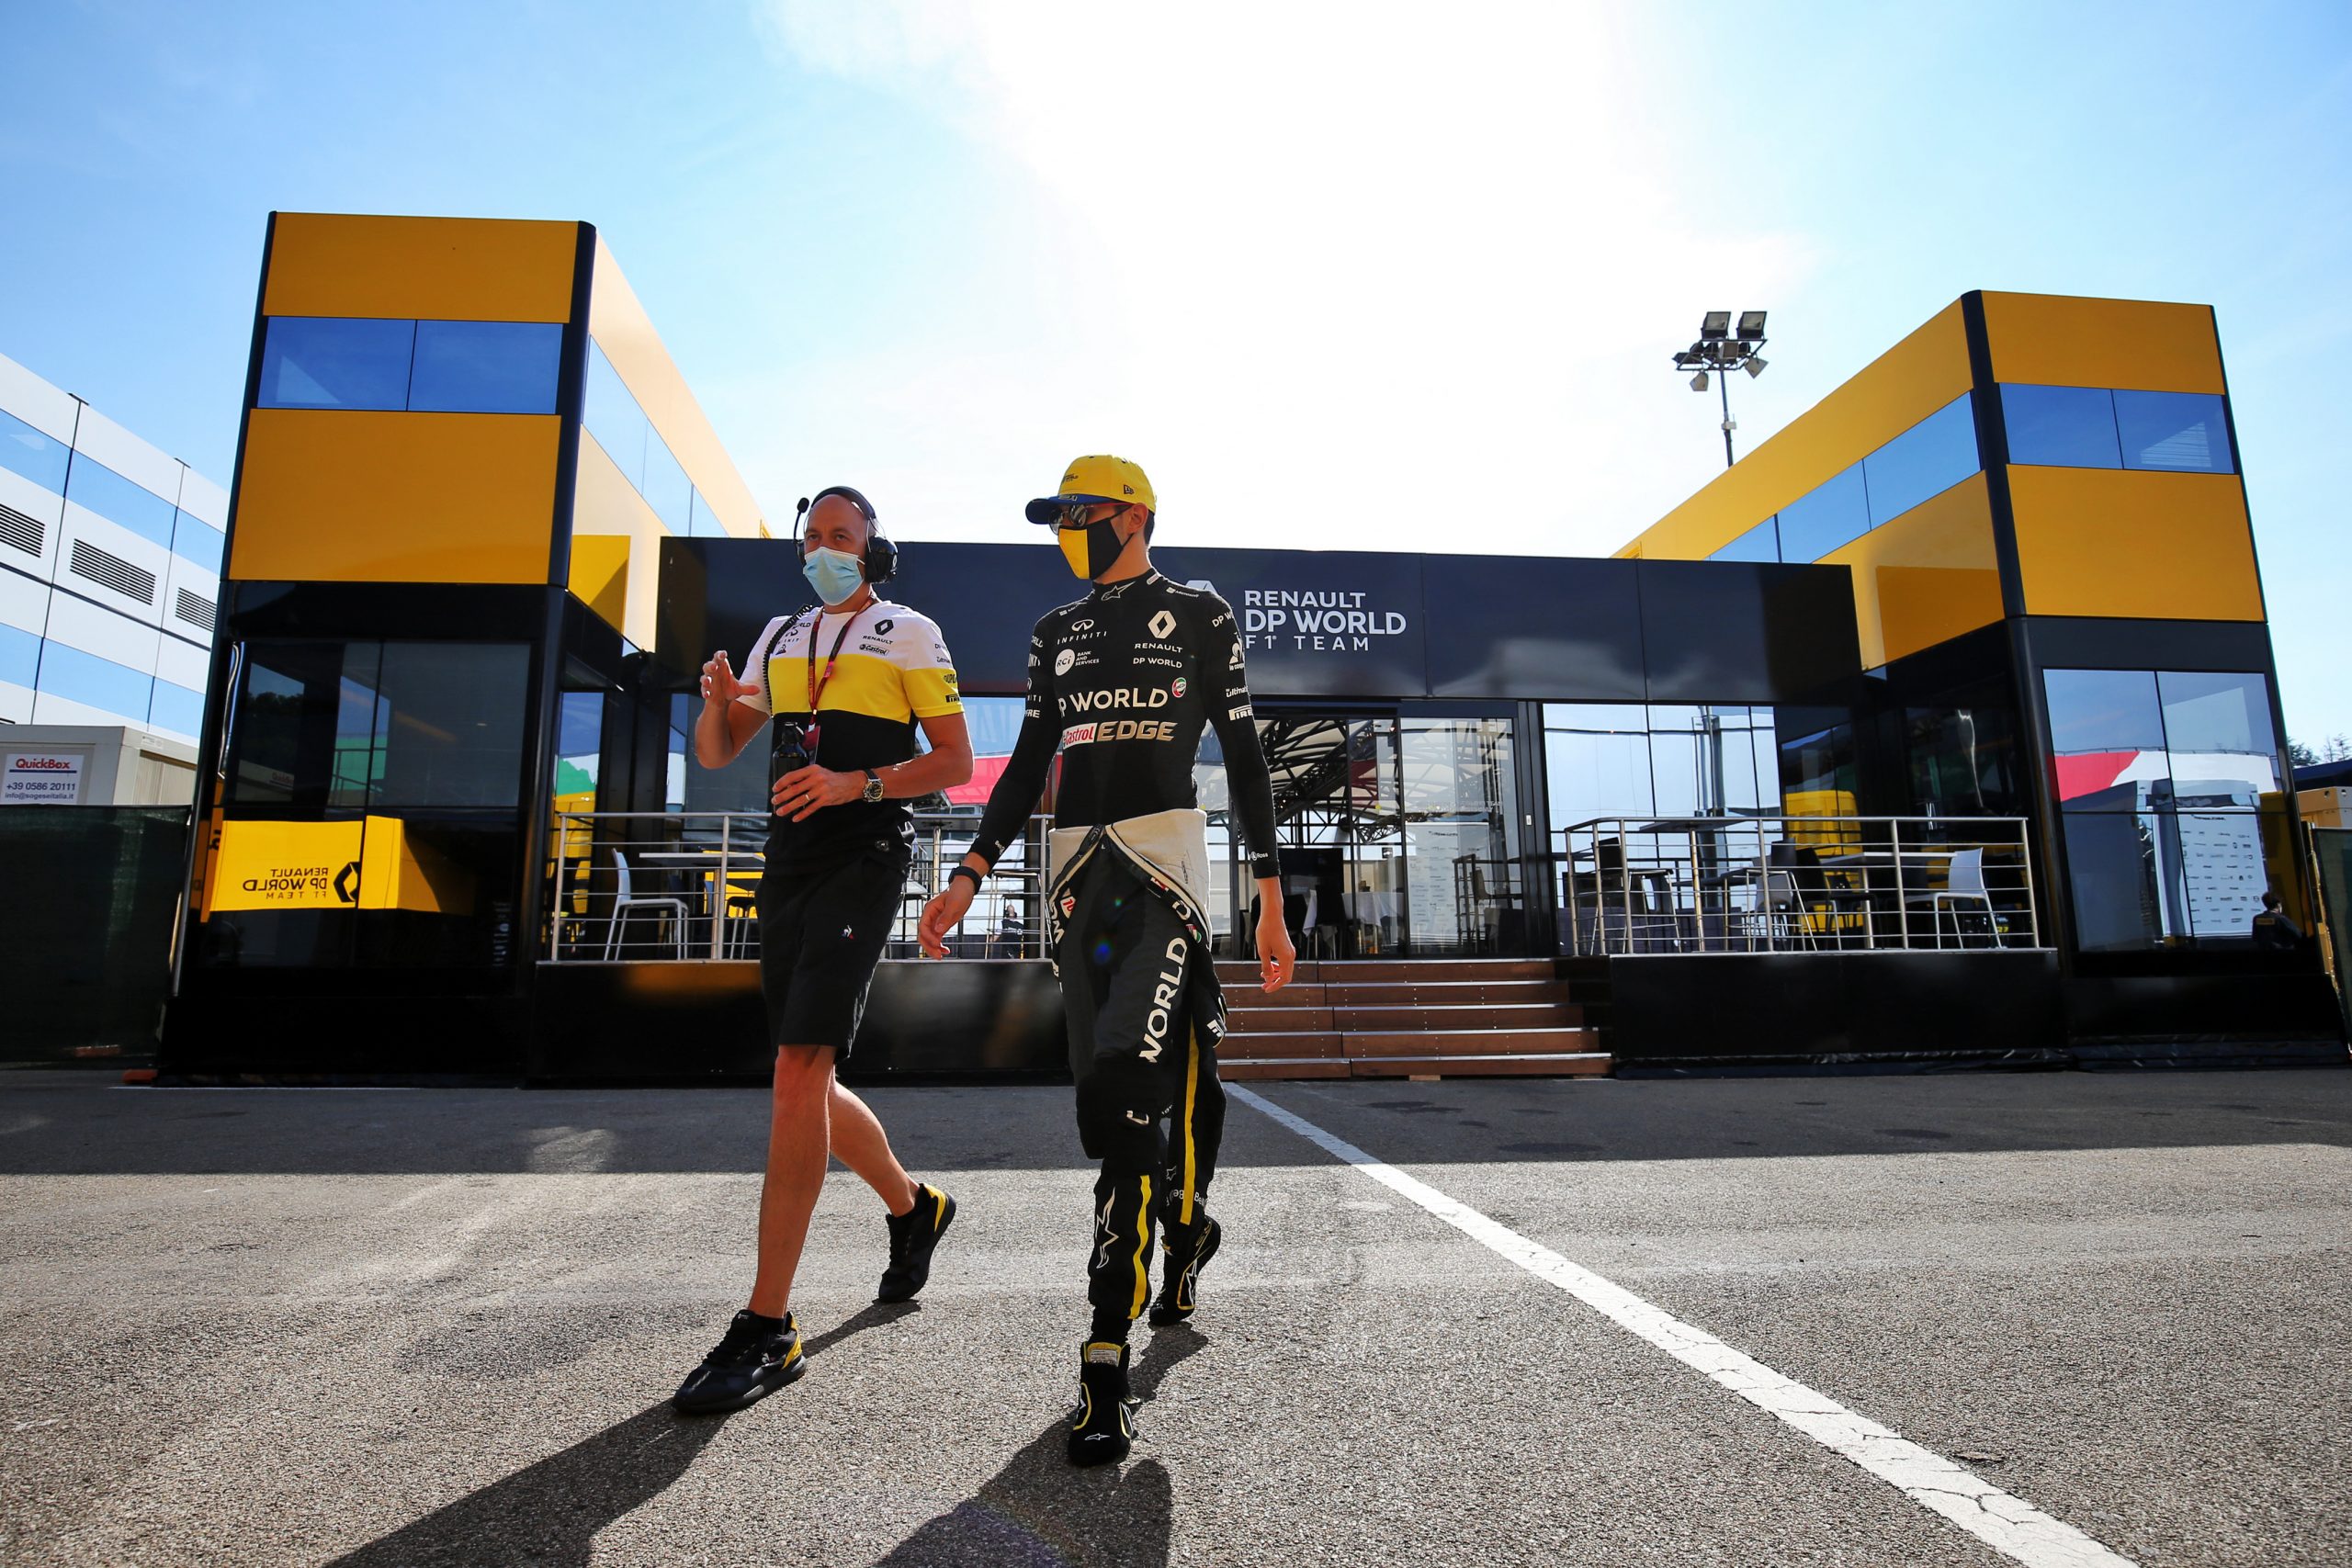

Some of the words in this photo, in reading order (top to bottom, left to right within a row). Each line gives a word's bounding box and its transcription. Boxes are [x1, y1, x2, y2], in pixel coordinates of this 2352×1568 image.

[1244, 590, 1366, 608] RENAULT
[1245, 609, 1286, 633] DP
[1292, 610, 1407, 635] WORLD
[863, 635, 894, 645] RENAULT
[1057, 630, 1107, 645] INFINITI
[1294, 636, 1369, 651] TEAM
[865, 645, 887, 655] Castrol
[1134, 643, 1183, 653] RENAULT
[1148, 658, 1182, 669] WORLD
[1069, 688, 1168, 713] WORLD
[1228, 705, 1252, 721] PIRE
[1096, 720, 1178, 742] EDGE
[16, 758, 70, 769] QuickBox
[6, 782, 24, 791] +39
[26, 782, 48, 791] 0586
[50, 783, 75, 791] 20111
